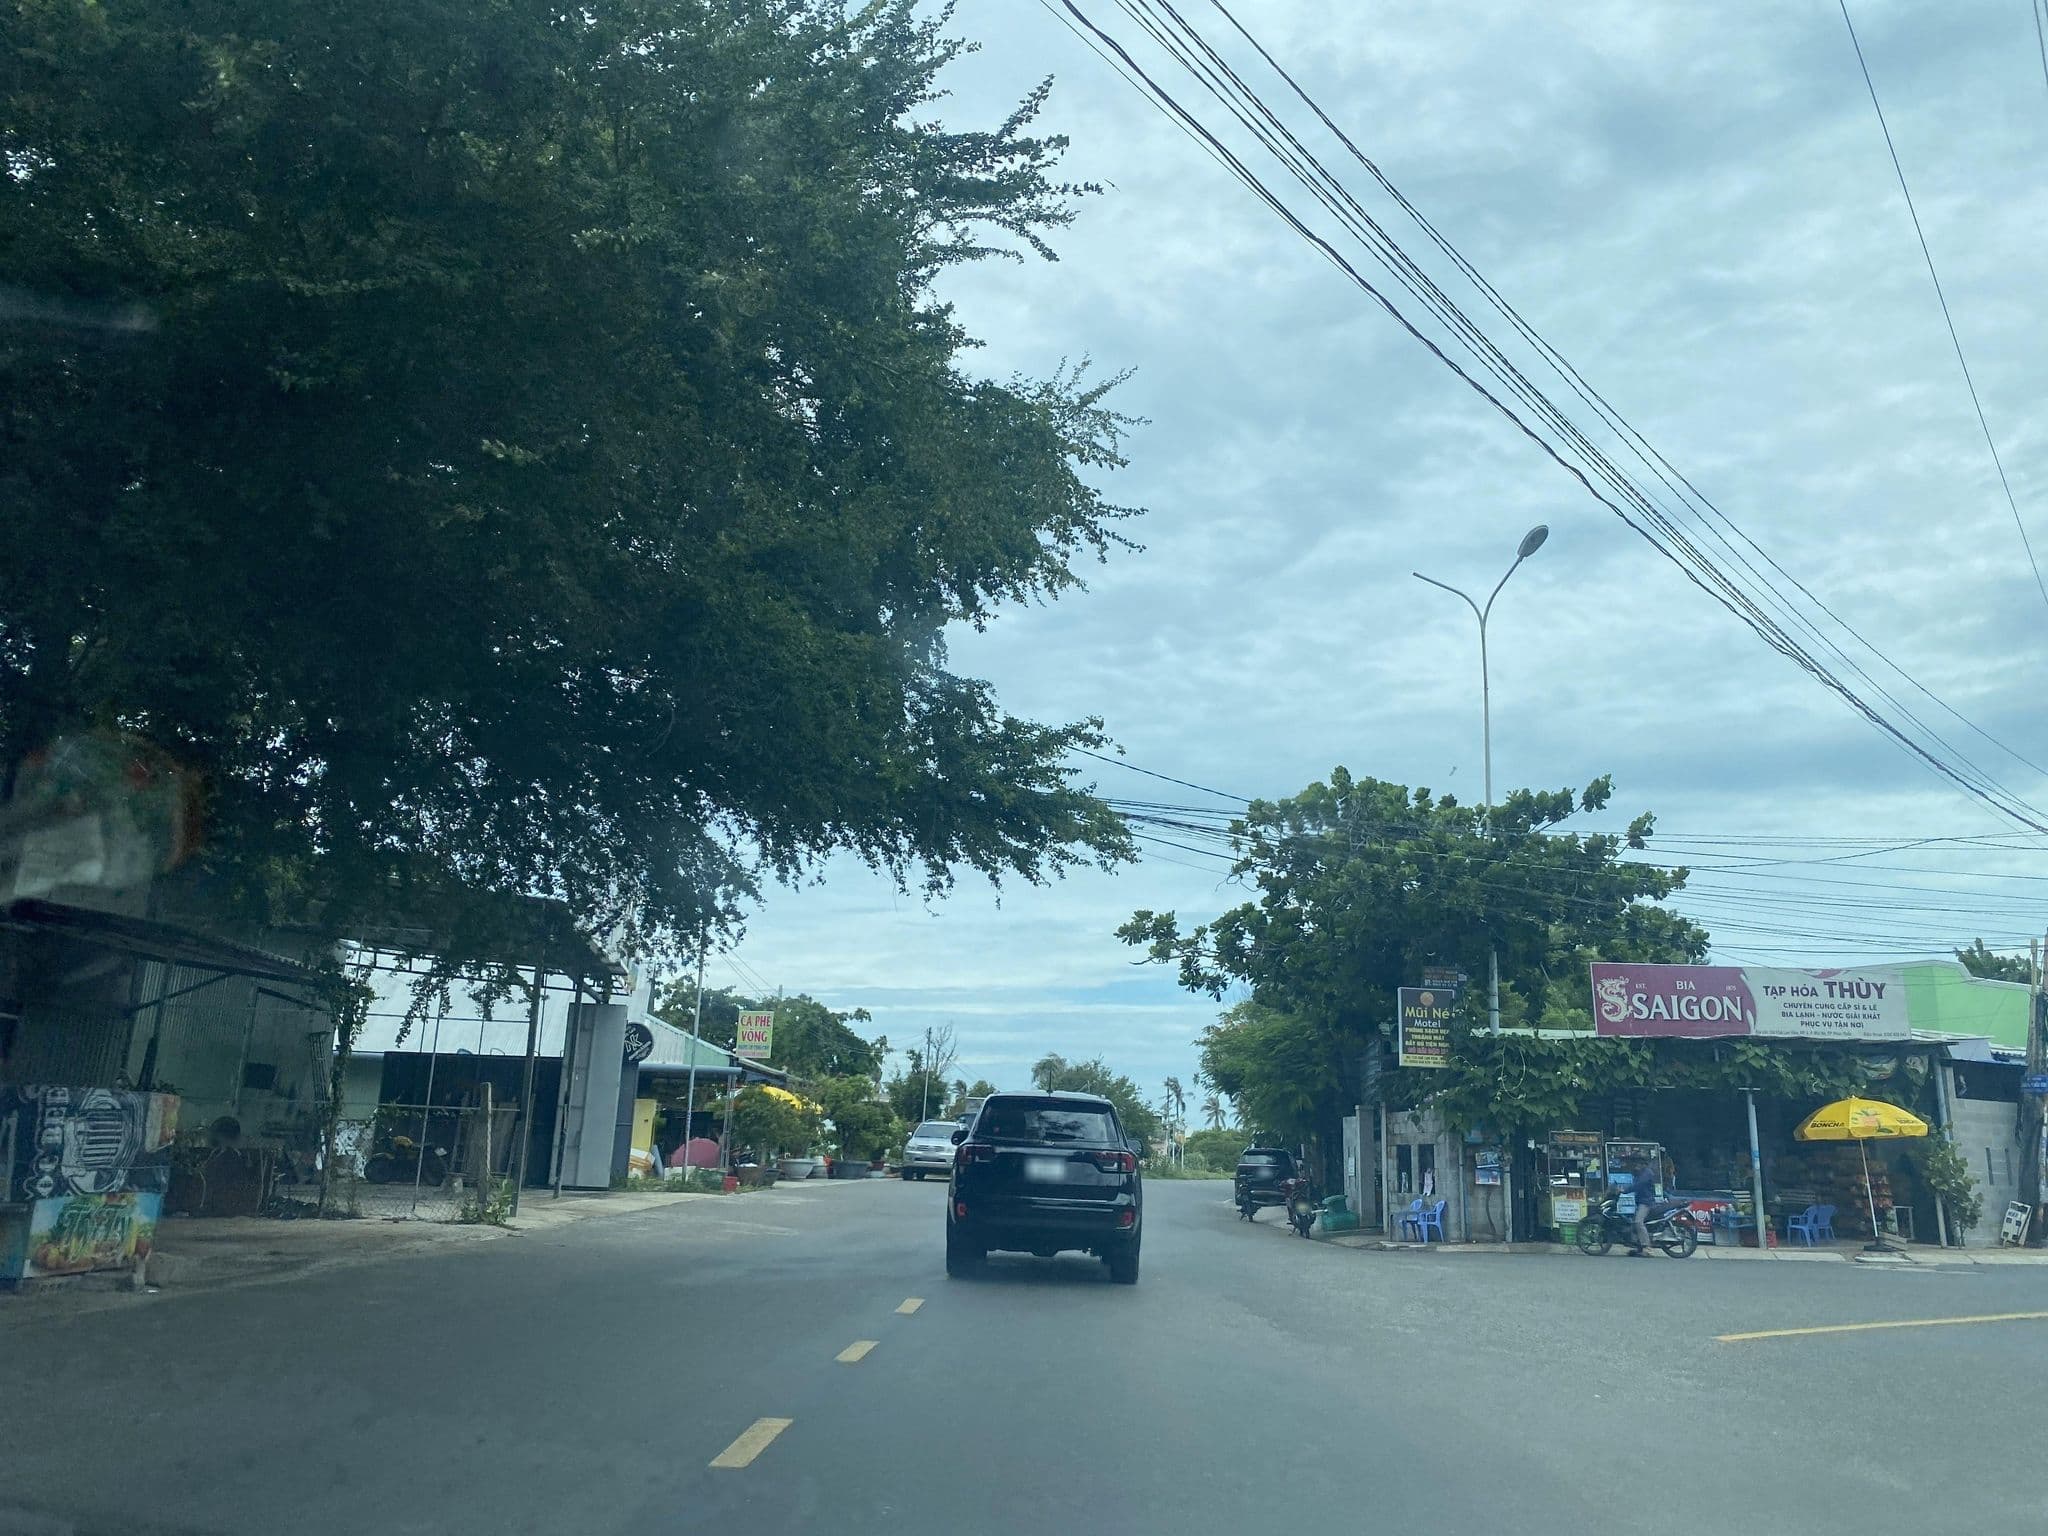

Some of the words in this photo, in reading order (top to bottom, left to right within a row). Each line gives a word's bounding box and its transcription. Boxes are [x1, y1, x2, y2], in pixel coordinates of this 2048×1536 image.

[1675, 980, 1696, 991] BIA
[1763, 985, 1786, 1000] TẠP
[1824, 976, 1886, 1000] THÙY
[1405, 1006, 1428, 1018] Mũi
[1433, 1007, 1450, 1019] Né
[1632, 993, 1743, 1022] SAIGON
[1414, 1019, 1441, 1028] Motel
